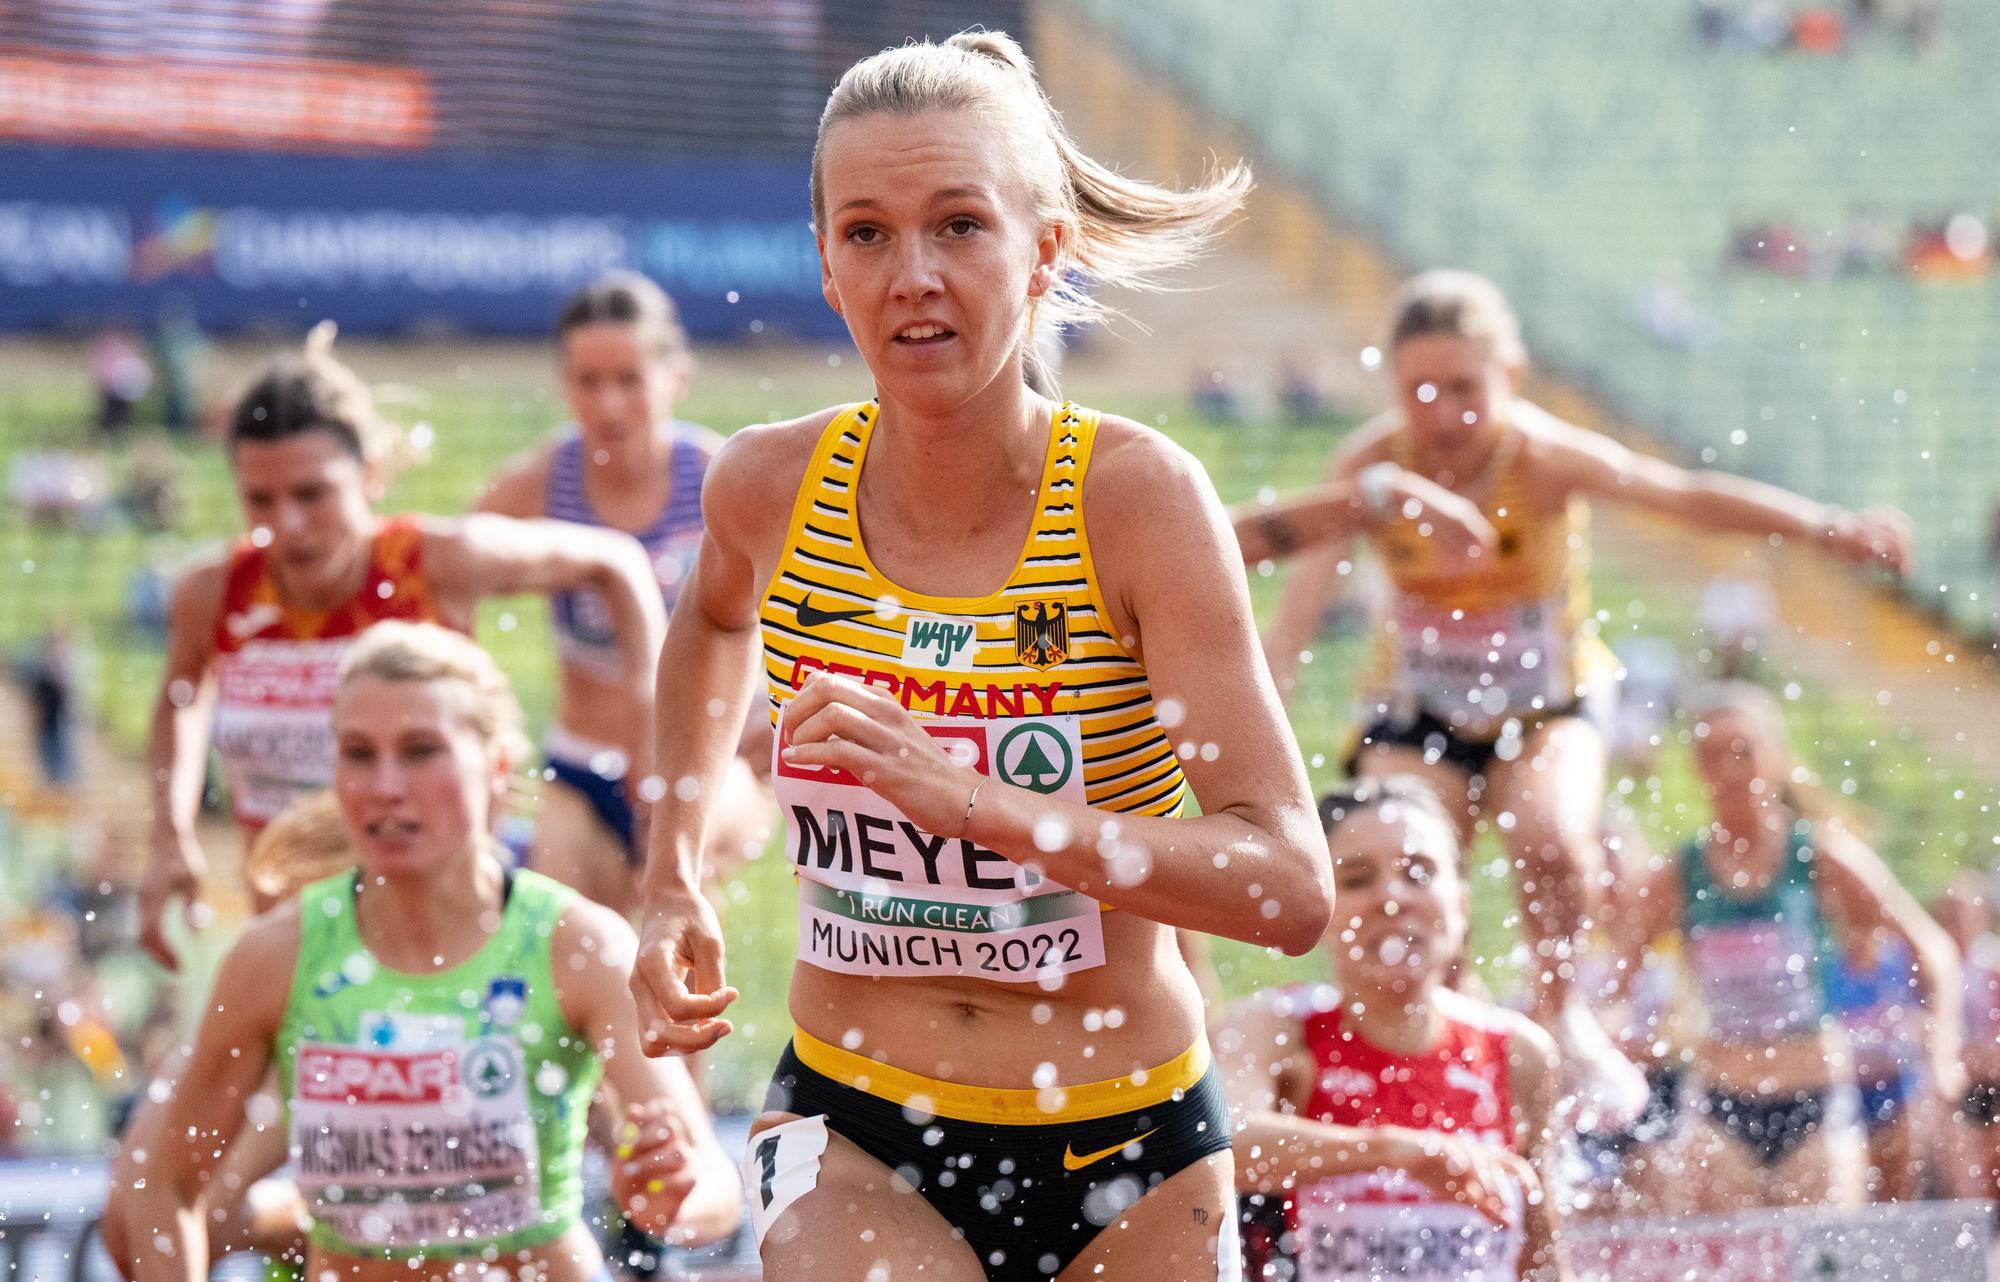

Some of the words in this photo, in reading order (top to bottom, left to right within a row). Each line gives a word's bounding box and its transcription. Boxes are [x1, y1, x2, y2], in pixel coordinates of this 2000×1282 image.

[791, 804, 1041, 890] MEYE
[861, 898, 916, 925] RUN
[812, 917, 962, 966] MUNICH
[975, 928, 1082, 973] 2022
[302, 1055, 453, 1097] SPAR
[753, 1133, 782, 1212] 1
